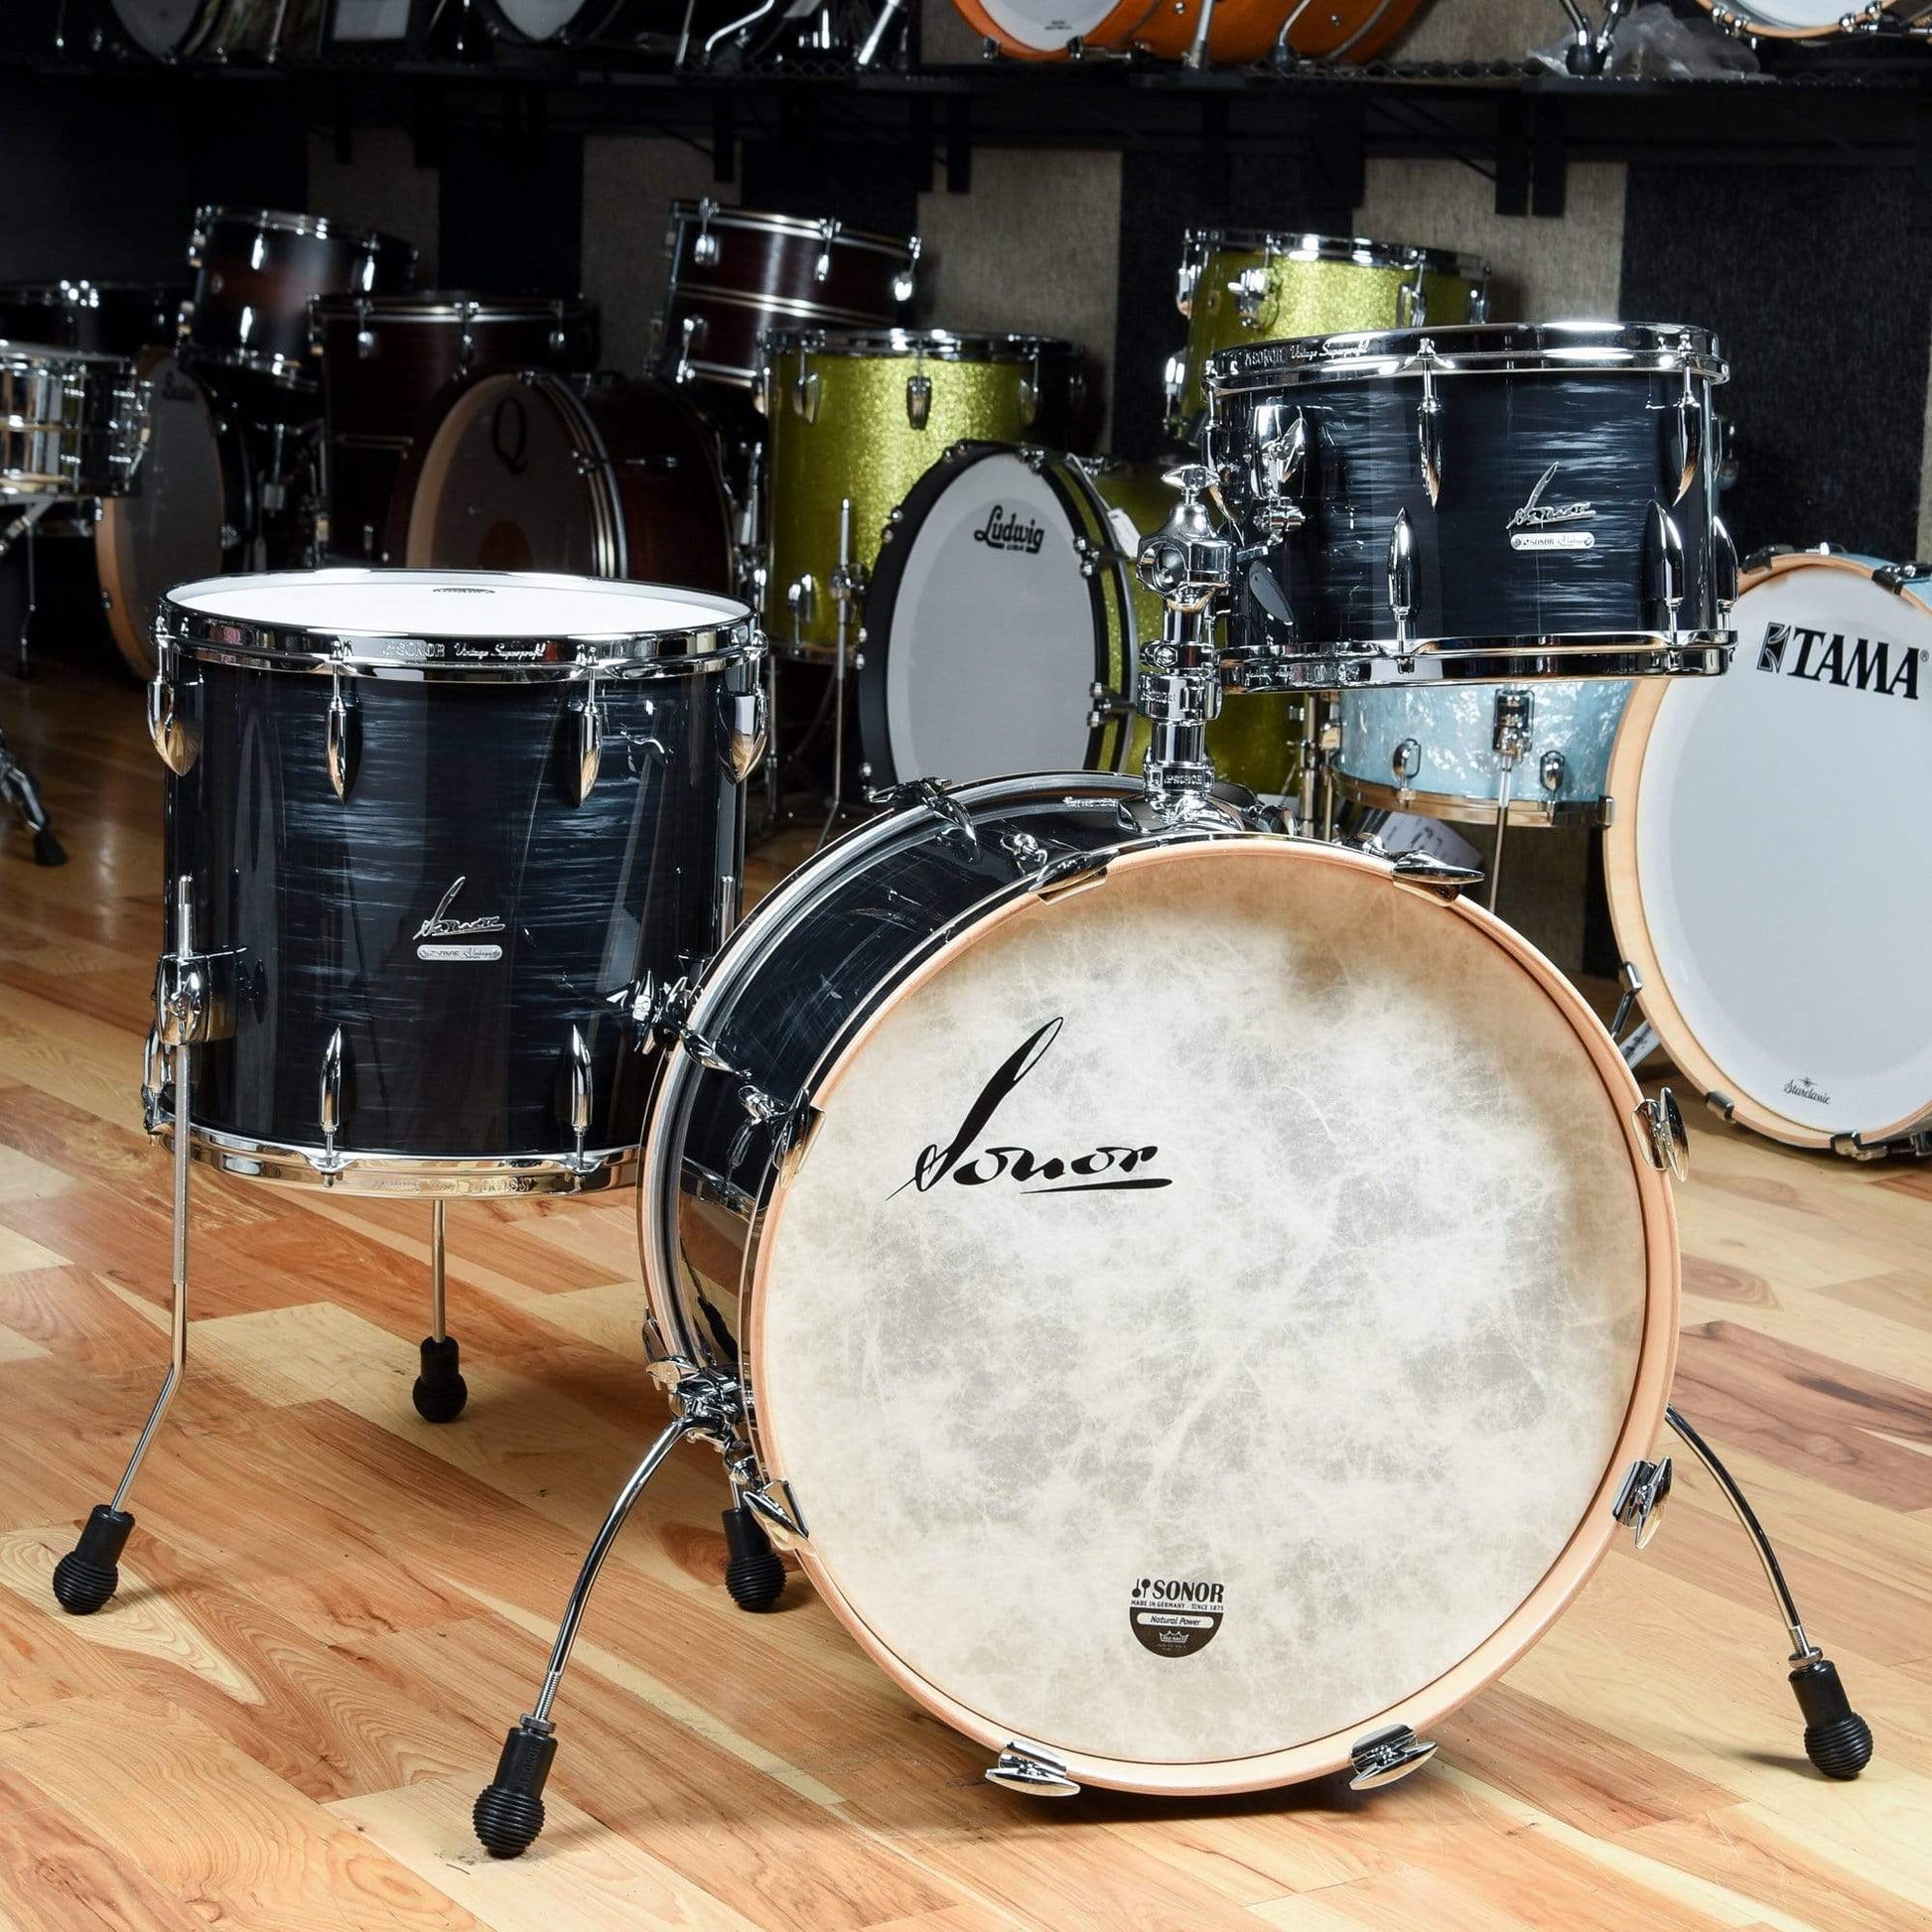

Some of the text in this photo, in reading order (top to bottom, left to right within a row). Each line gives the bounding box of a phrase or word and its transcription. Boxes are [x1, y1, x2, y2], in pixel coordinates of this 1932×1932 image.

[492, 395, 527, 475] Q
[974, 504, 1044, 554] Ludwig
[1787, 626, 1919, 700] TAMA
[885, 1017, 1173, 1201] Sonor
[1150, 1615, 1201, 1626] Natural Power
[1152, 1579, 1224, 1603] SONOR
